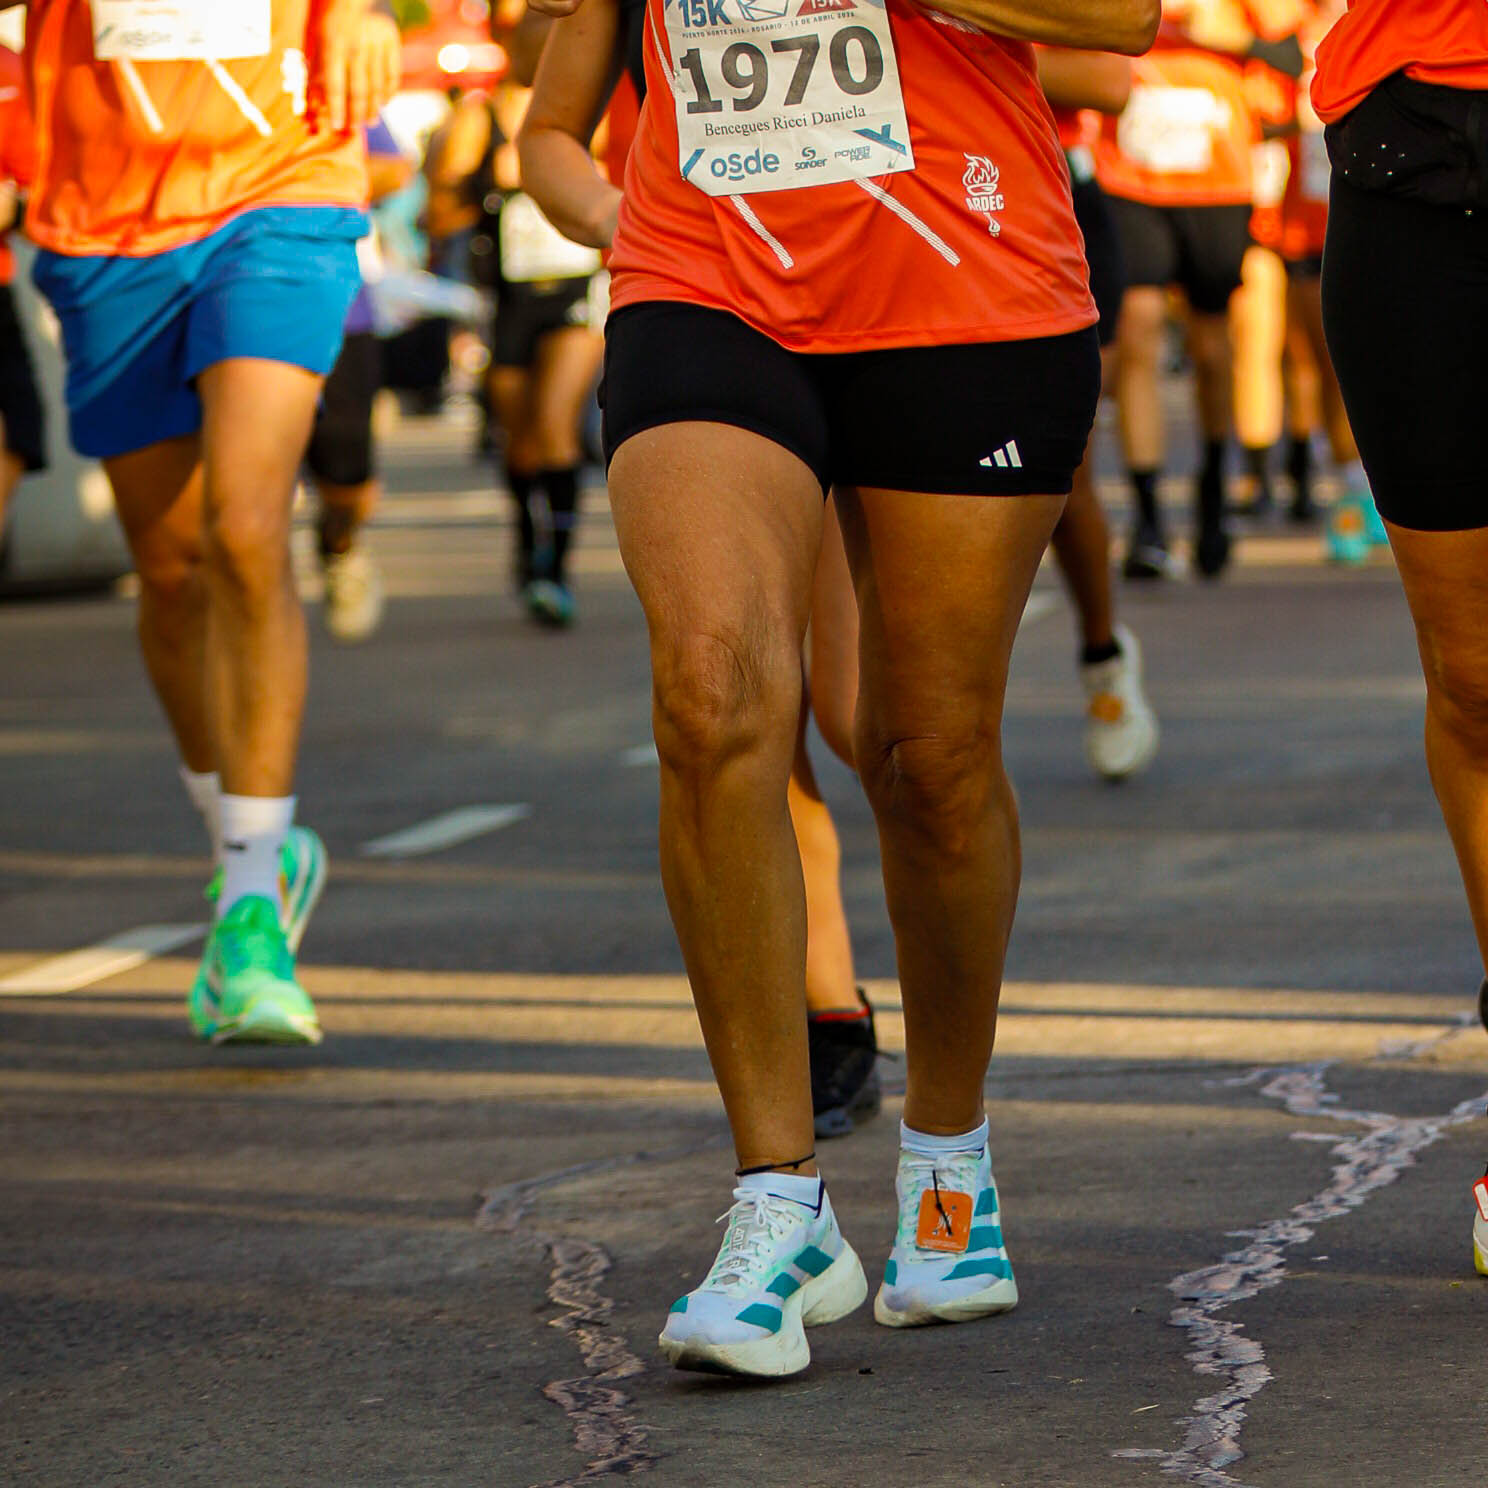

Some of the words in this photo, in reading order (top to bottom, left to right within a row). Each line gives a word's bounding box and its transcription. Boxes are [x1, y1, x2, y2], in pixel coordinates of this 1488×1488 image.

[680, 25, 884, 114] 1970
[704, 121, 770, 137] Bencegues
[773, 114, 809, 130] Ricci
[811, 104, 867, 125] Daniela
[710, 147, 780, 181] osde
[965, 194, 1005, 211] ARDEC
